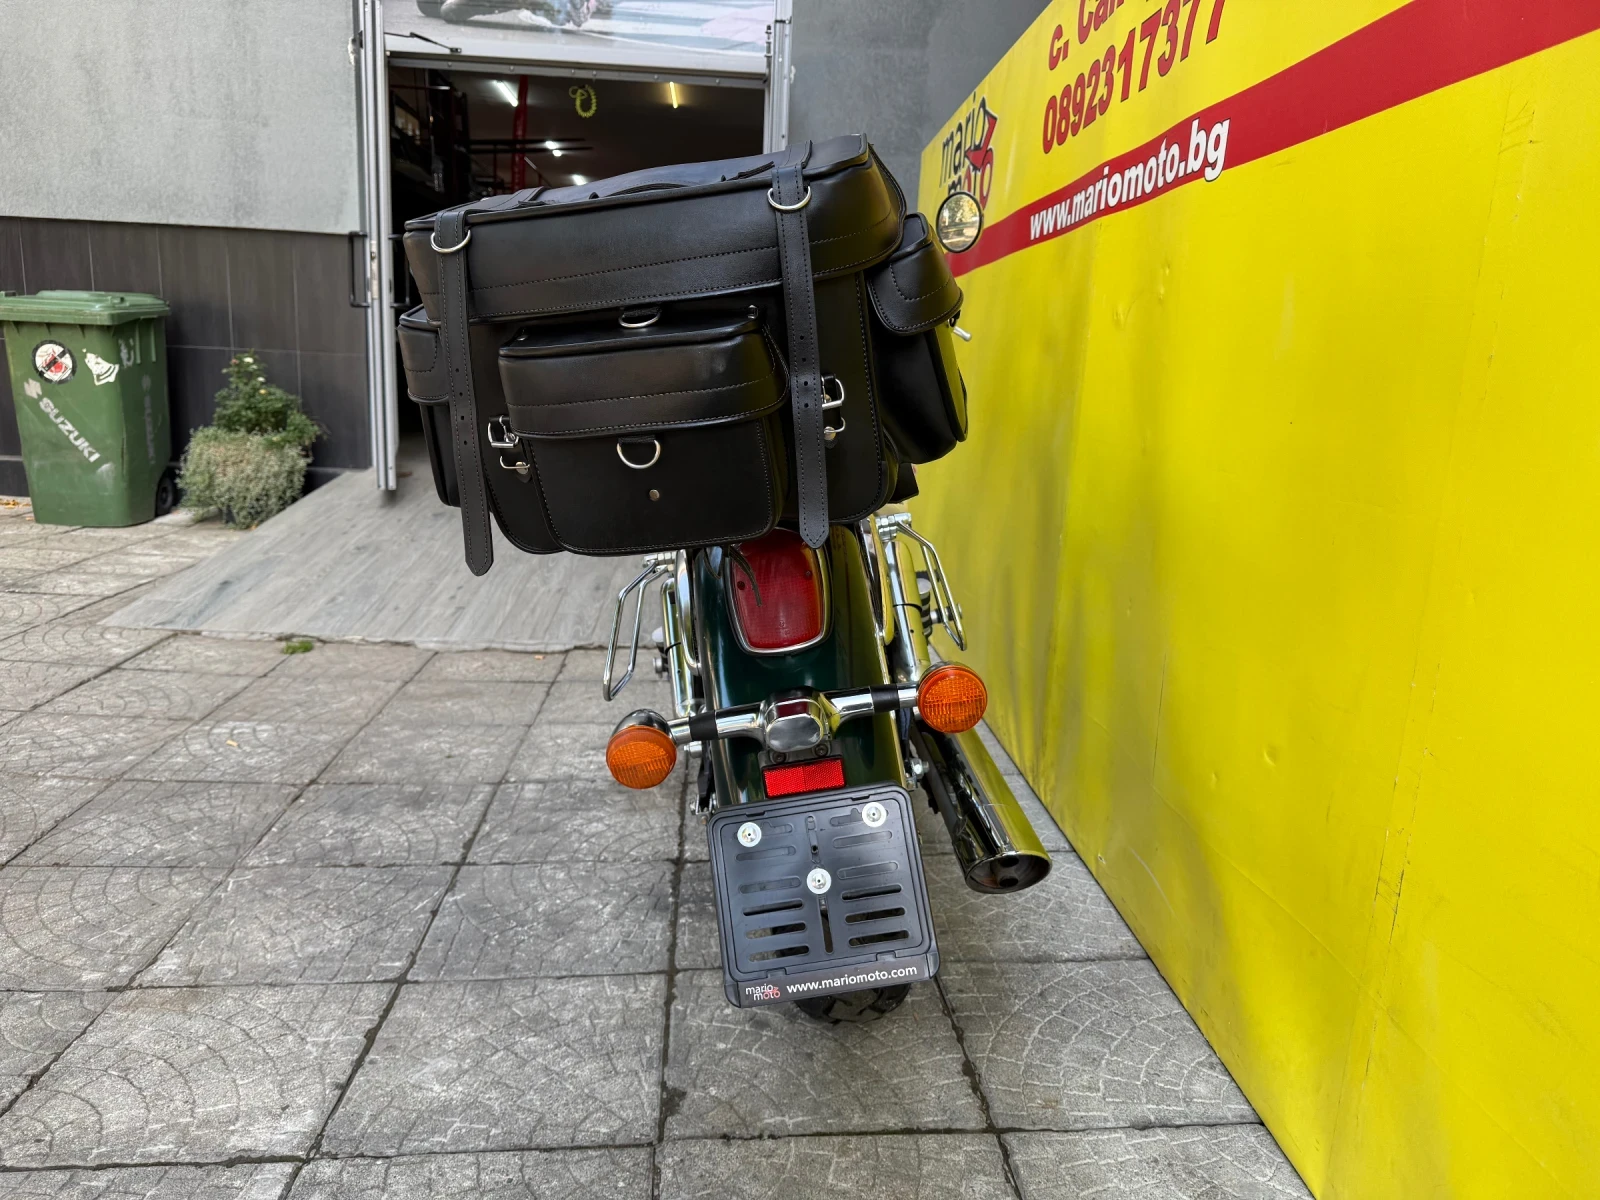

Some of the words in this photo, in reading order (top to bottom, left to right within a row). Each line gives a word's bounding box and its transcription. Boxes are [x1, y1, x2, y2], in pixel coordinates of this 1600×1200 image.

[939, 91, 986, 188] mario
[1030, 118, 1230, 240] www.mariomoto.bg
[39, 397, 101, 463] SUZUKI
[745, 983, 773, 995] mario
[753, 990, 780, 1001] moto
[786, 966, 917, 993] www.mariomoto.com
